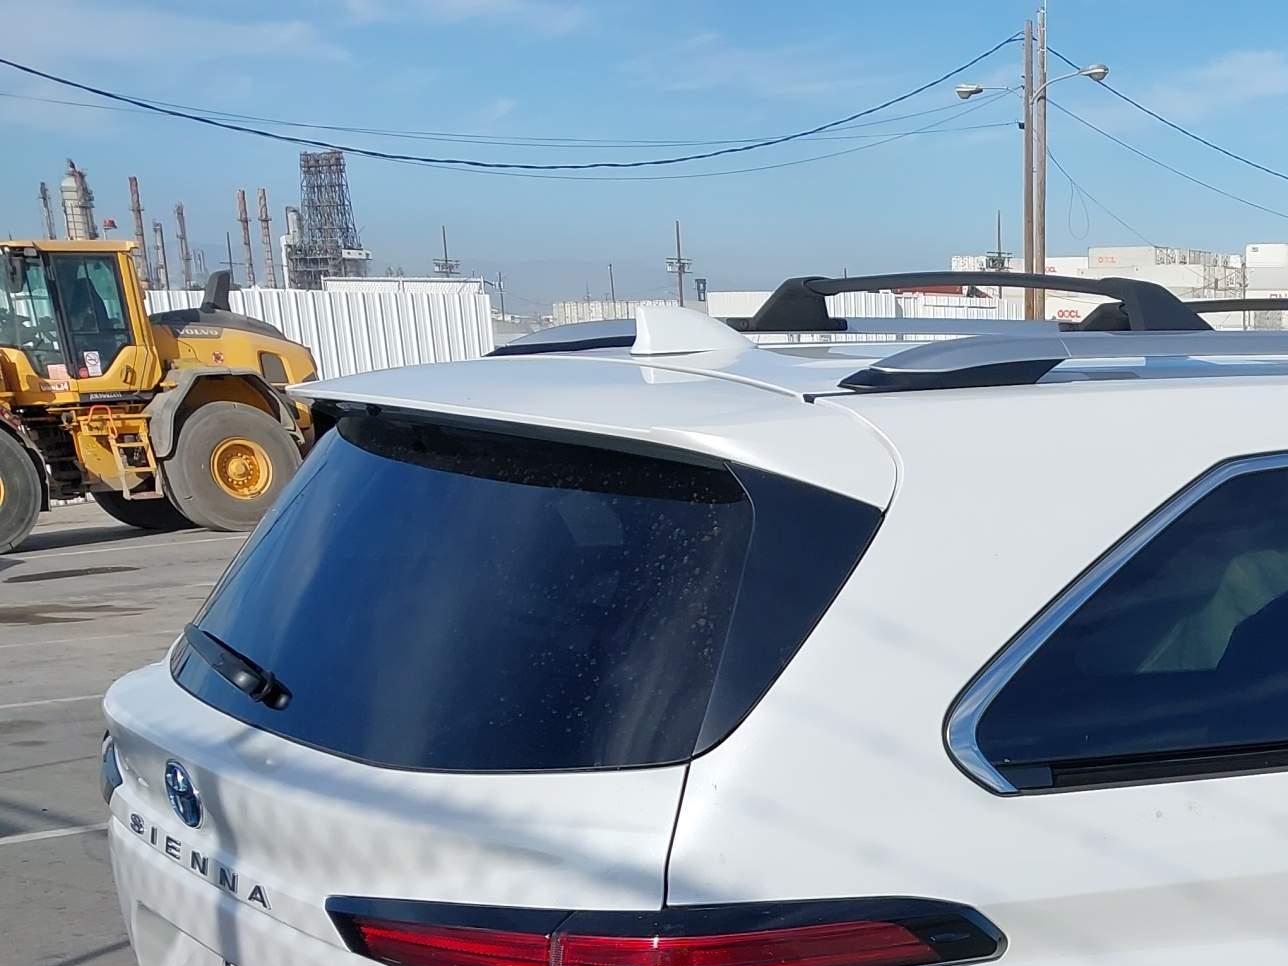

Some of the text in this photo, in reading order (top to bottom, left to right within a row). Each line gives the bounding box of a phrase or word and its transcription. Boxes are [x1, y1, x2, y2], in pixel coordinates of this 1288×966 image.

[1057, 309, 1081, 319] OOCL
[176, 328, 218, 336] VOLVO
[129, 813, 272, 911] SIENNA
